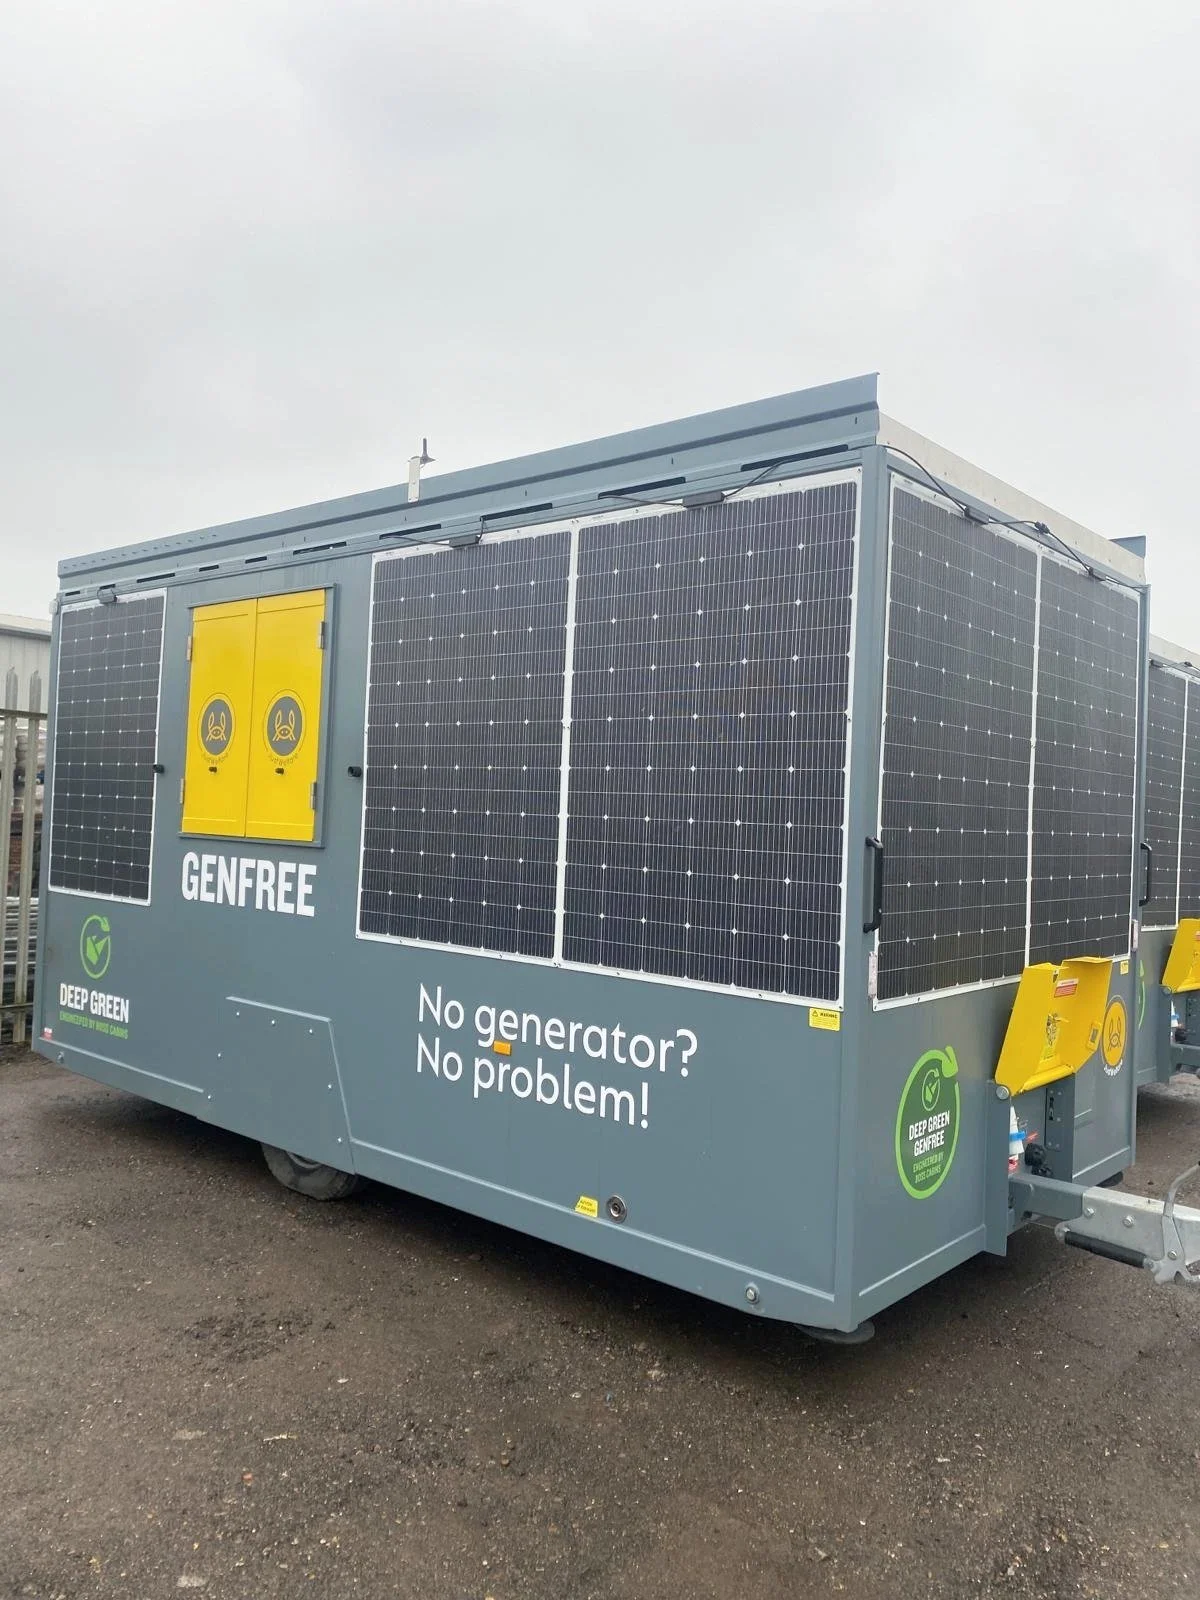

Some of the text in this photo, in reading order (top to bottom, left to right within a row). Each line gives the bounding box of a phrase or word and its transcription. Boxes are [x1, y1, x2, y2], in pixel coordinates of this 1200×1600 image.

[182, 852, 317, 917] GENFREE
[60, 983, 129, 1024] DEEP GREEN
[418, 984, 698, 1077] No generator?
[416, 1034, 650, 1129] No problem!
[909, 1110, 950, 1140] DEEP GREEN
[914, 1130, 945, 1157] GENFREE
